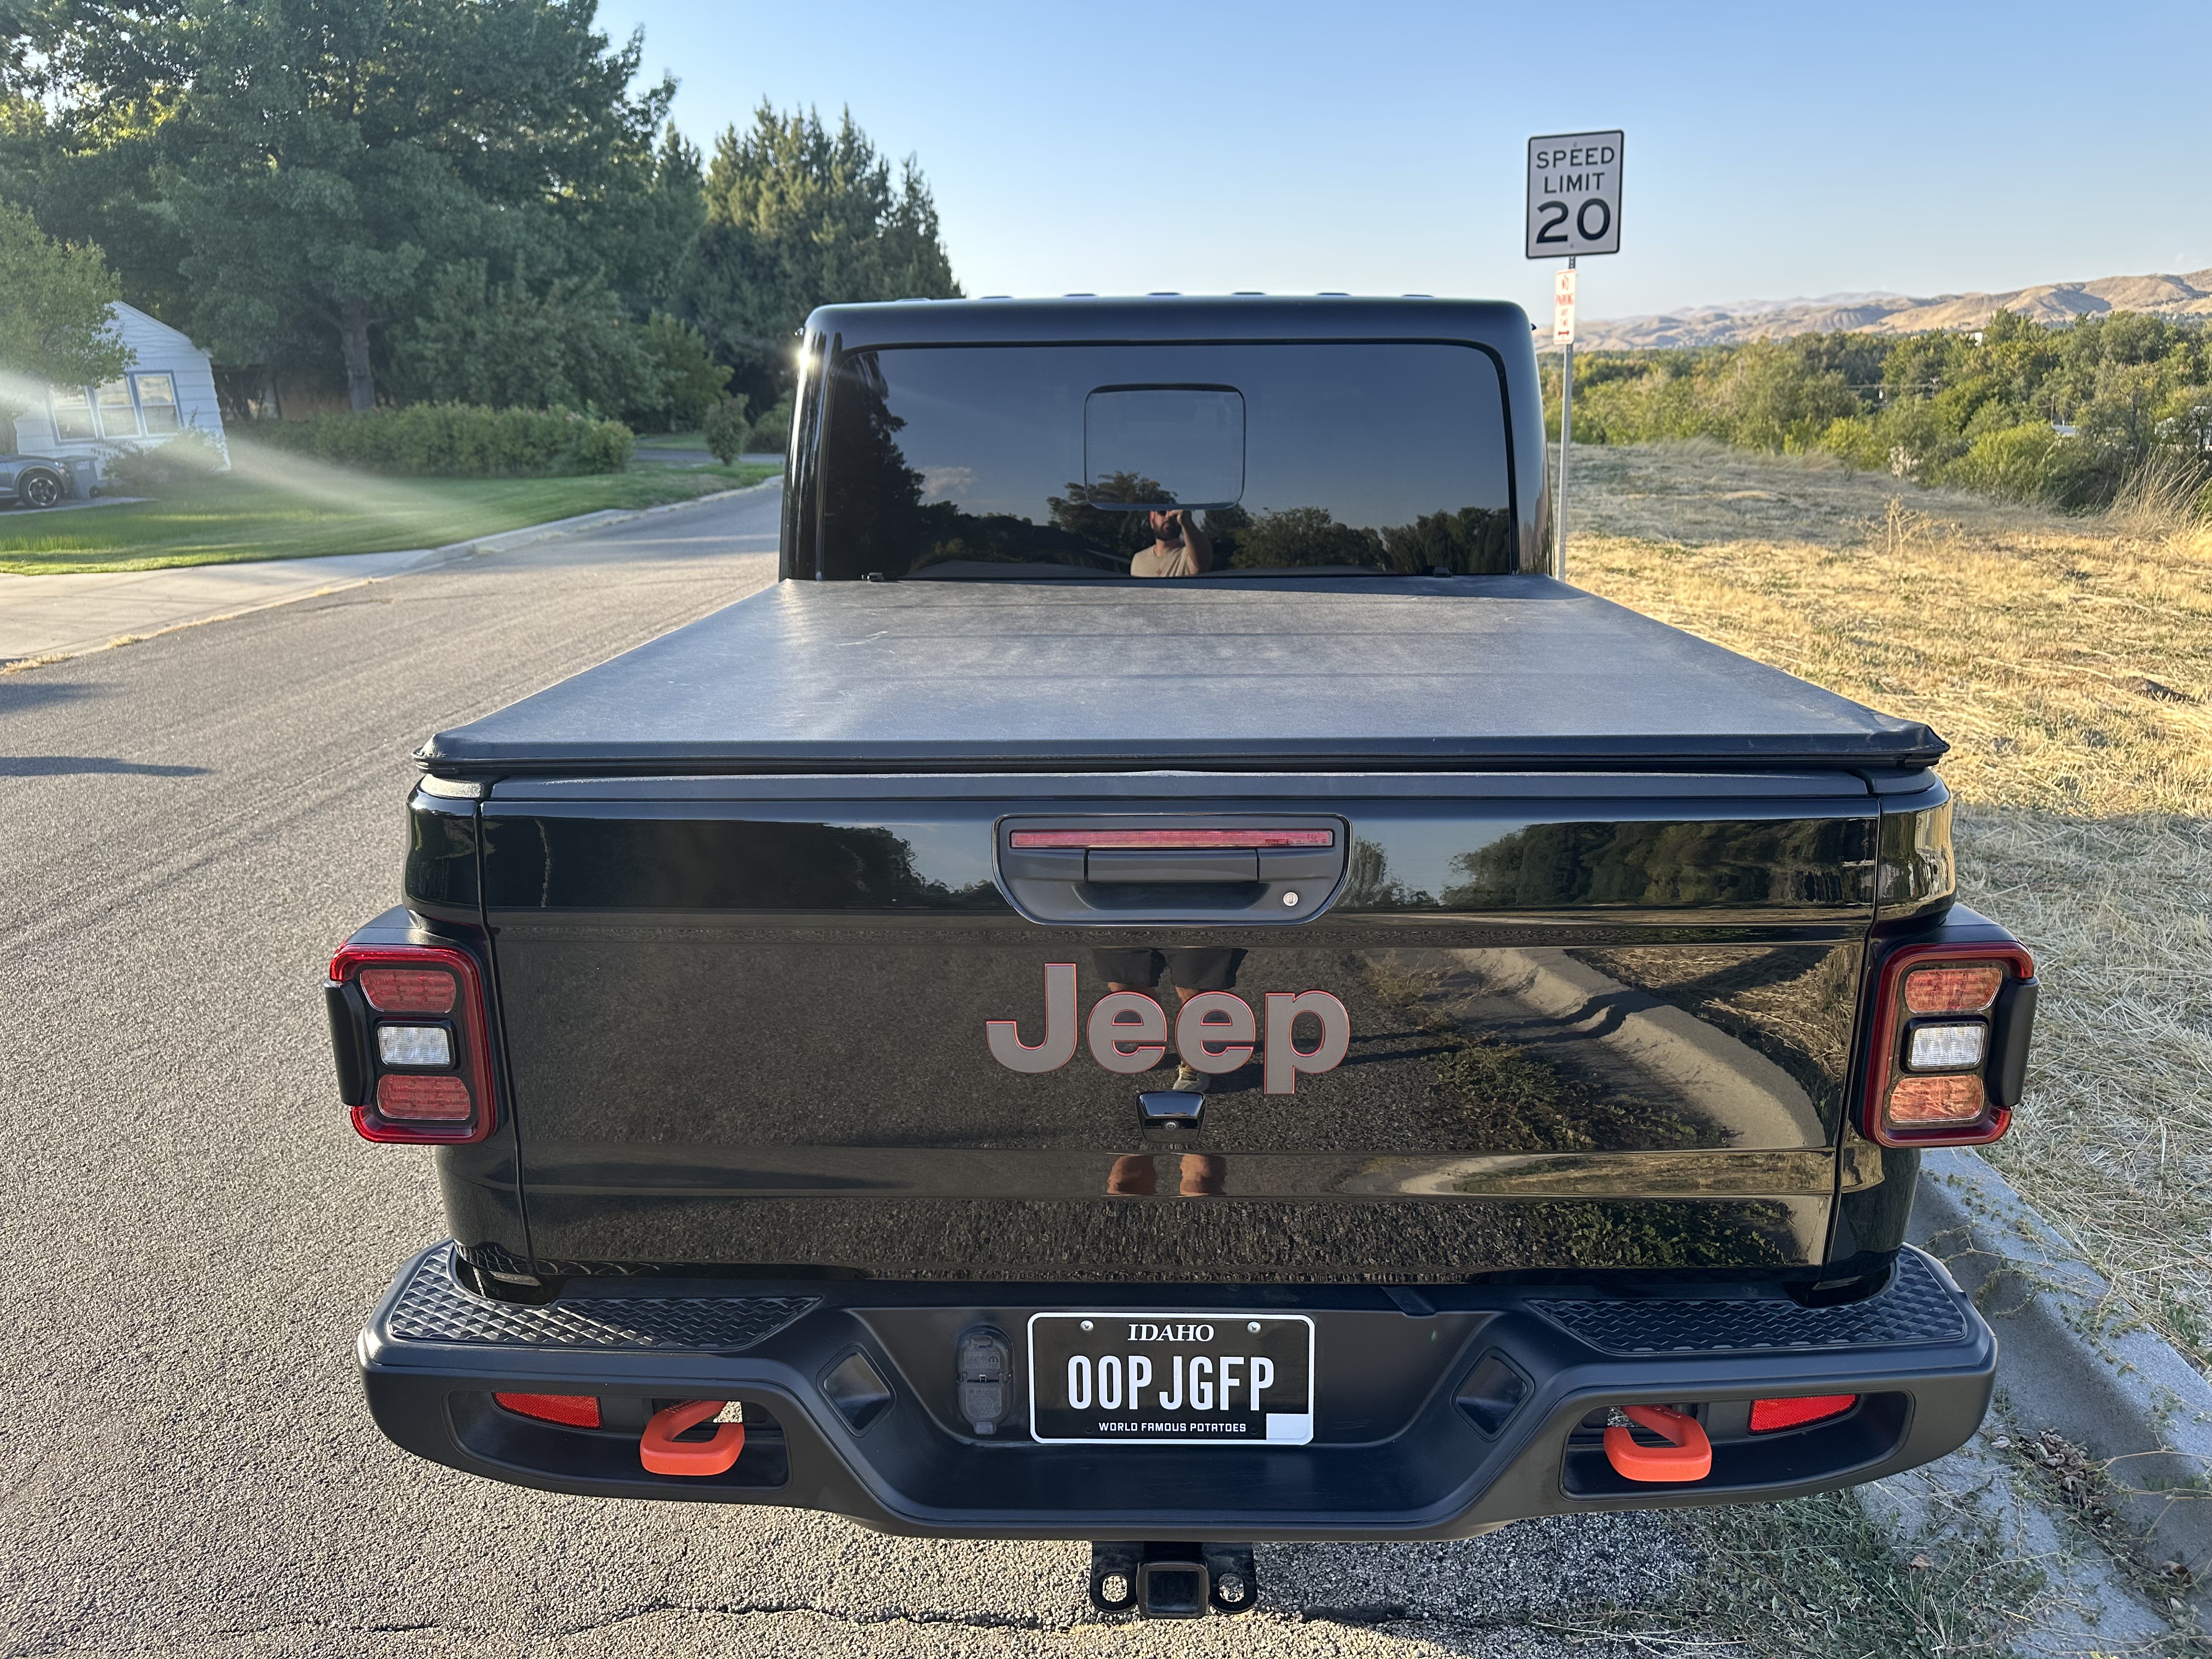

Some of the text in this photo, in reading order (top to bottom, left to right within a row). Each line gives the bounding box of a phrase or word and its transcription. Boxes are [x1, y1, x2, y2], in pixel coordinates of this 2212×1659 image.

[1536, 146, 1616, 169] SPEED
[1544, 172, 1605, 194] LIMIT
[1535, 198, 1611, 244] 20
[986, 963, 1350, 1094] Jeep
[1127, 1323, 1215, 1342] IDAHO
[1098, 1422, 1246, 1432] WORLD FAMOUS POTATOES
